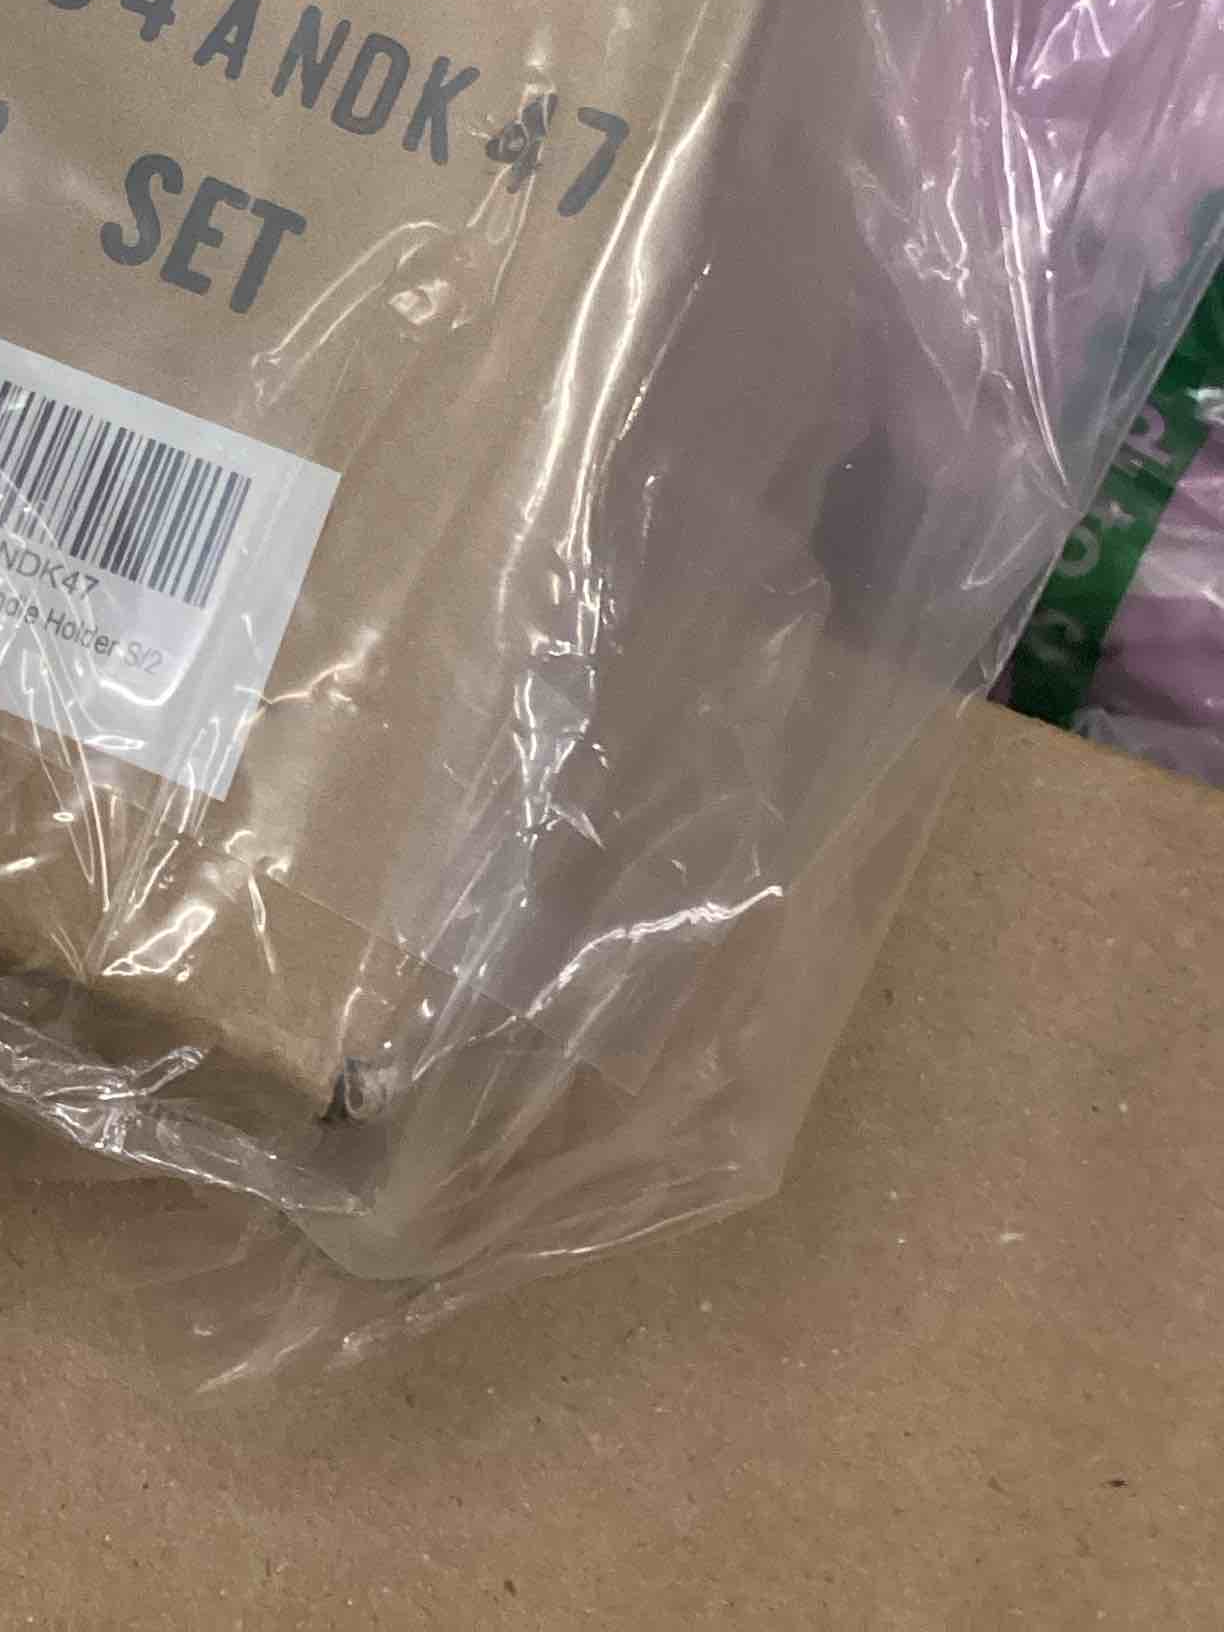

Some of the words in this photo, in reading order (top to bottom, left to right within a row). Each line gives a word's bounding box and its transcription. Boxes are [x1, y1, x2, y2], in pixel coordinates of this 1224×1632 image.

[100, 154, 307, 313] SET
[42, 608, 119, 658] Holder
[126, 641, 164, 673] S/2
